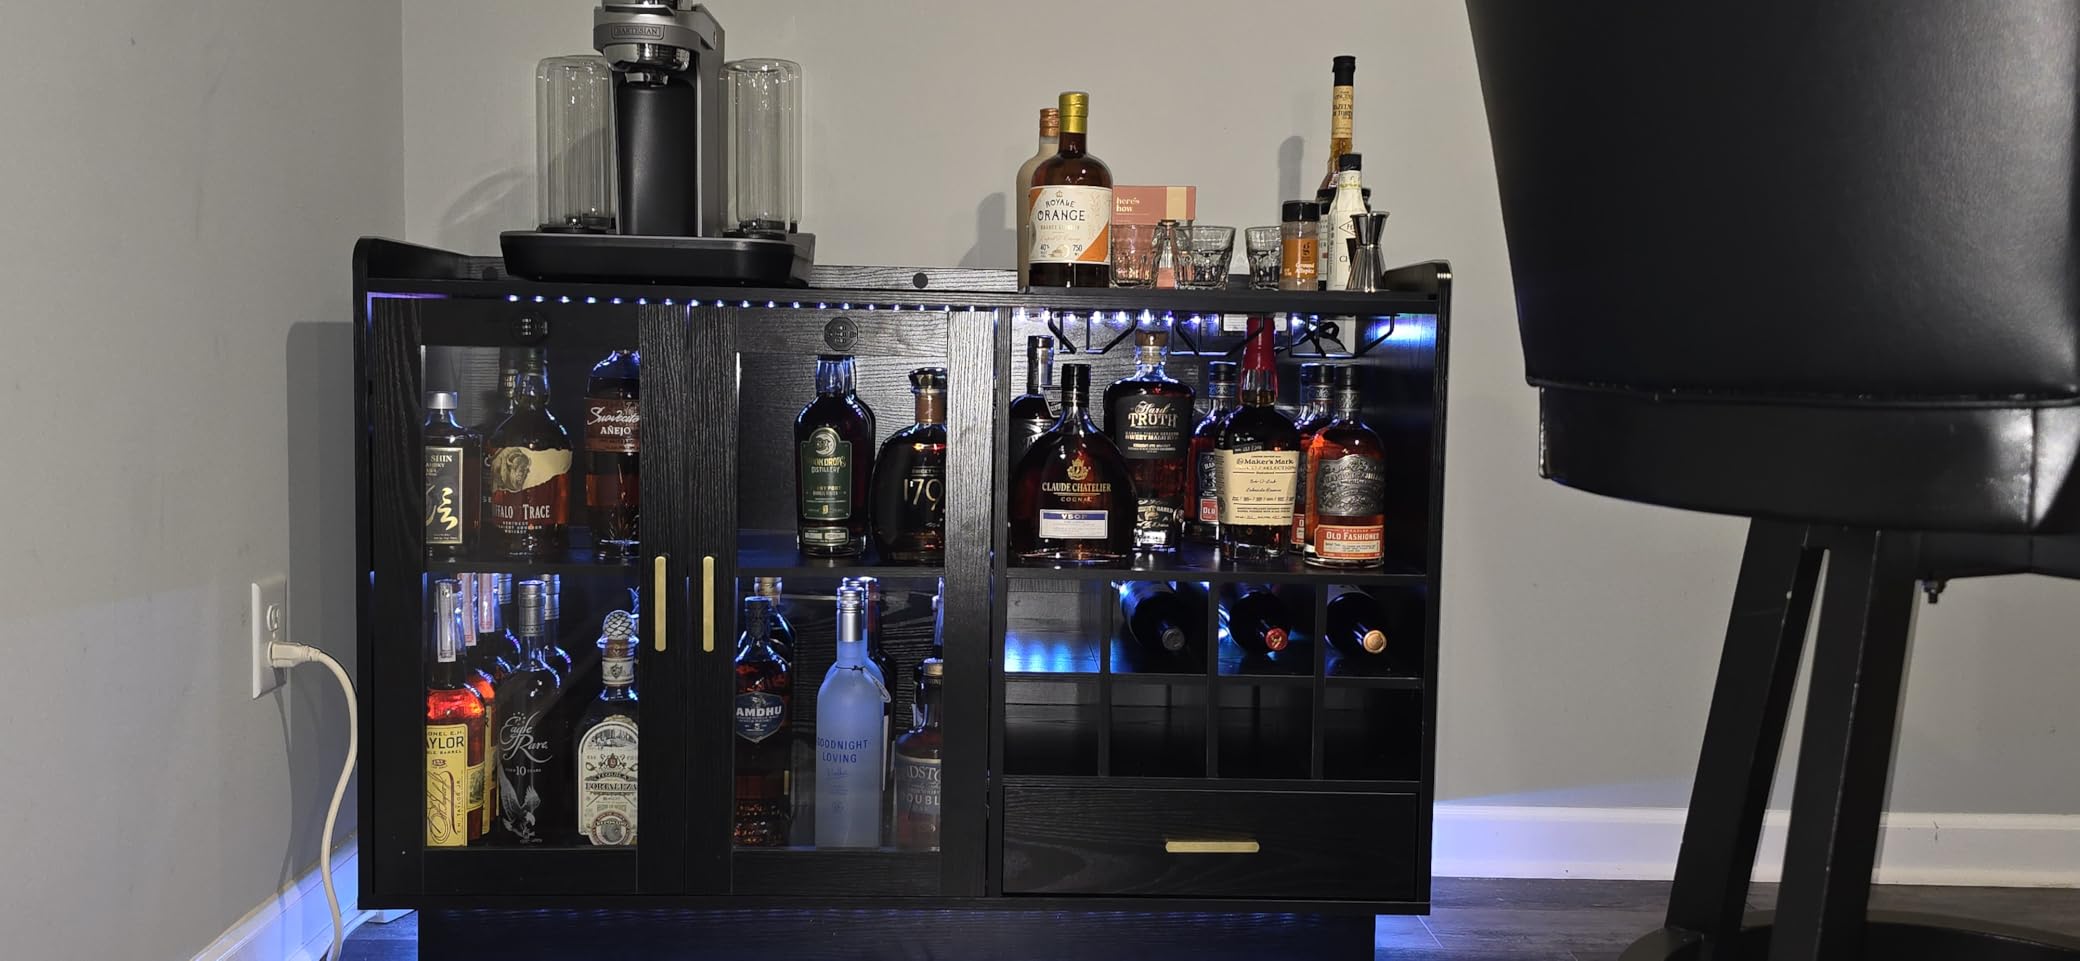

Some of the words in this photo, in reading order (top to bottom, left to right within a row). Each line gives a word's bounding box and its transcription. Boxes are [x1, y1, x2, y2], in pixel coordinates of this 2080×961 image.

[1038, 210, 1085, 221] ORANGE
[1073, 244, 1083, 252] 750
[587, 406, 640, 425] Suavecito
[1128, 412, 1178, 428] TRUTH
[600, 425, 631, 436] AÑEJO
[1042, 482, 1071, 492] CLAUDE
[1072, 483, 1112, 493] CHATELIER
[904, 478, 945, 511] 179
[523, 504, 550, 520] TRACE
[1326, 531, 1341, 540] OLD
[736, 705, 782, 717] AMDHU
[500, 710, 541, 750] Eagle
[503, 734, 553, 763] Rare
[817, 737, 868, 751] GOODNIGHT
[822, 752, 857, 763] LOVING
[516, 766, 527, 776] 10
[585, 782, 637, 791] FORTALEZA
[906, 793, 941, 805] OUBL
